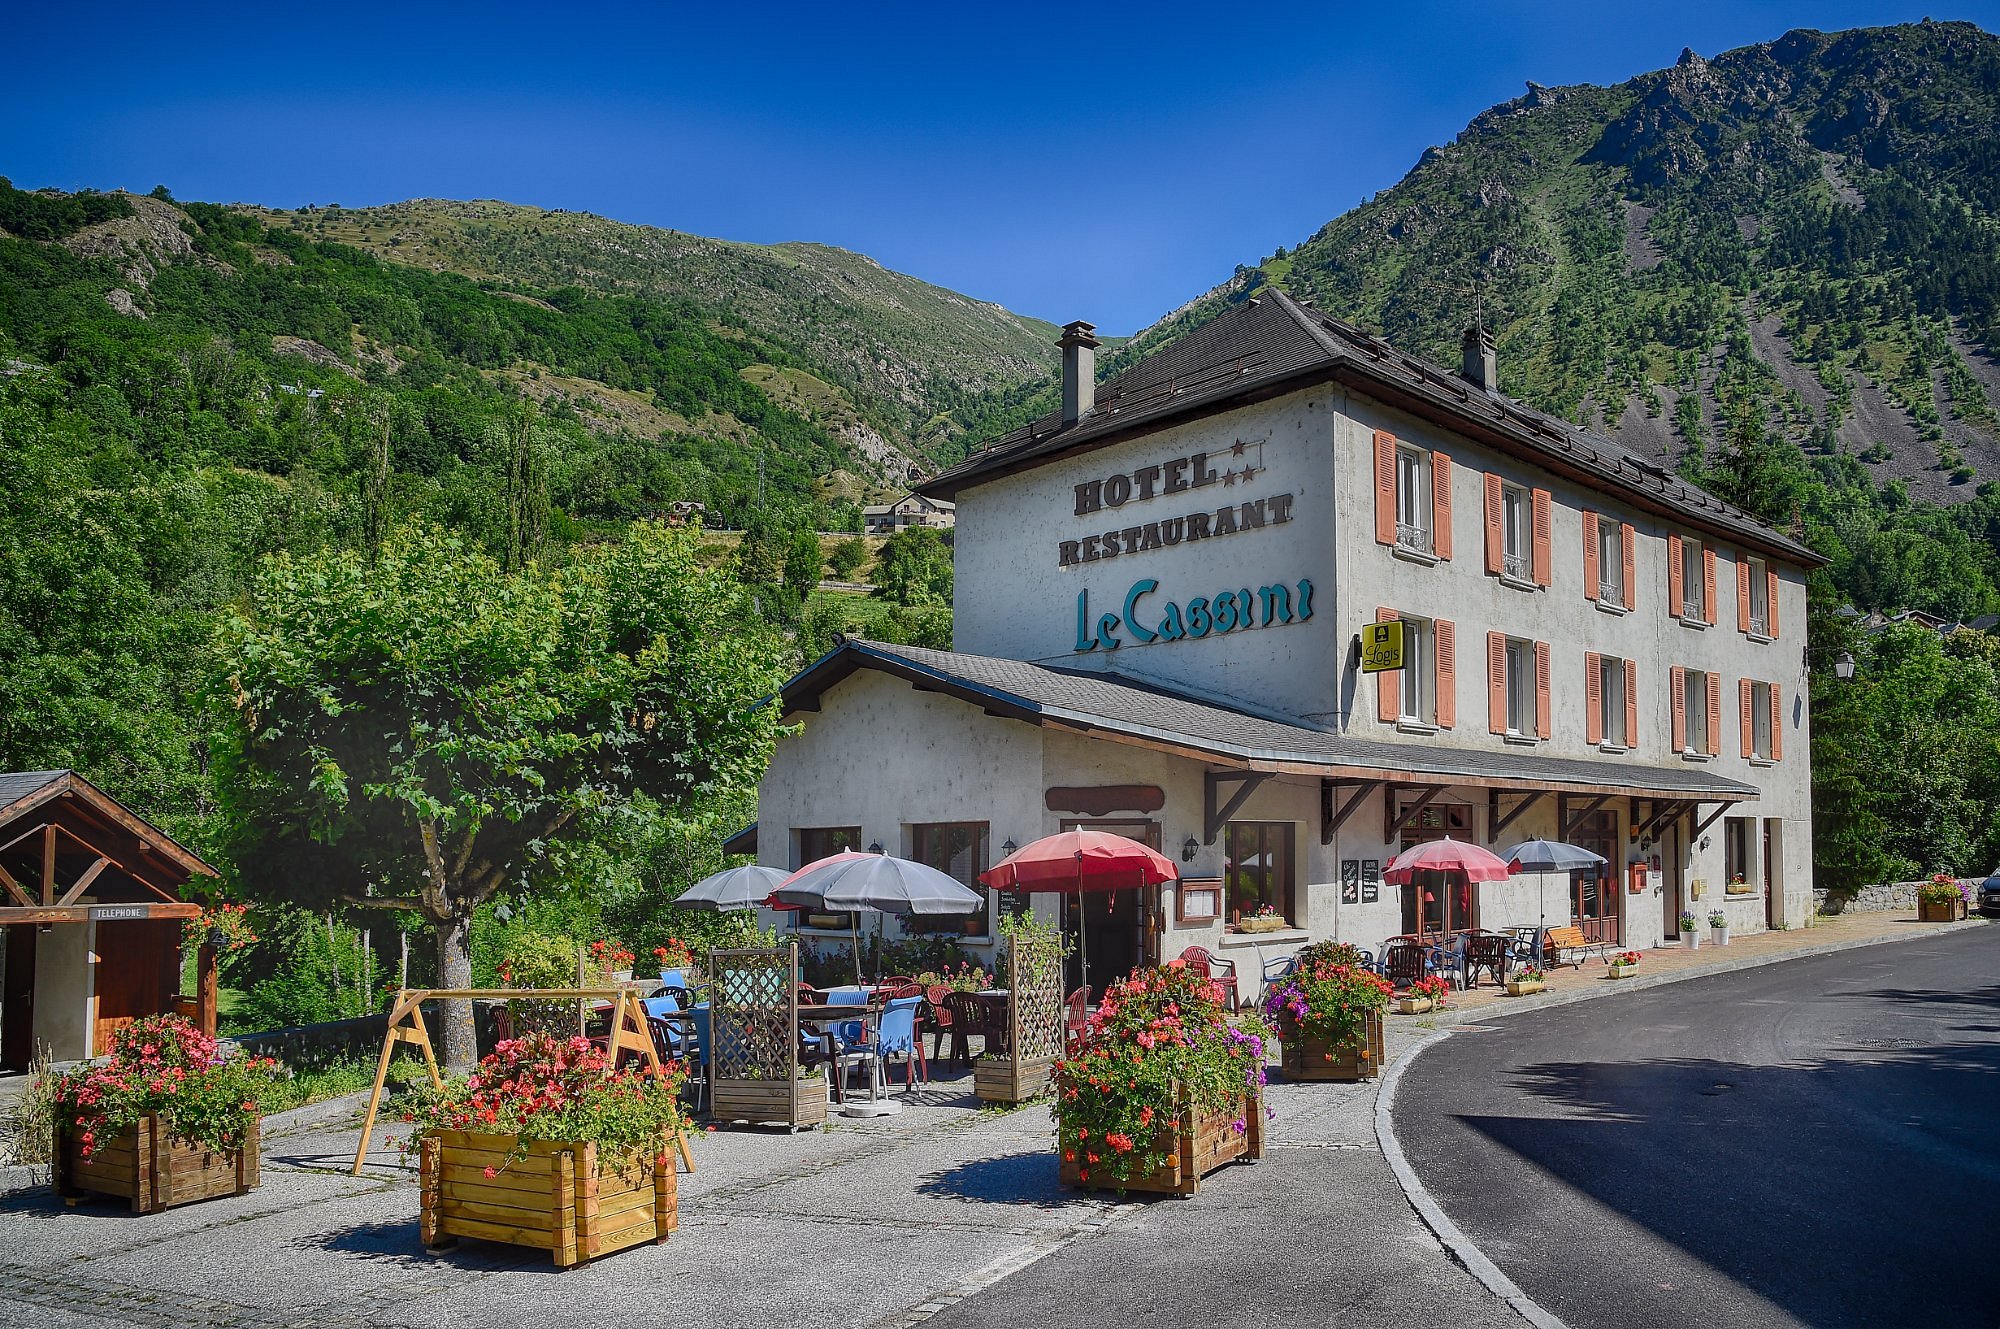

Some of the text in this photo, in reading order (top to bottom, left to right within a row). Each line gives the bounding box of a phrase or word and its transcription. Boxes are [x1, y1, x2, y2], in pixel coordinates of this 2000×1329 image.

[1074, 453, 1216, 516] HOTEL
[1059, 493, 1293, 567] RESTAURANT
[1073, 578, 1313, 651] Le Cassini
[1364, 643, 1399, 666] Logis
[97, 908, 141, 918] TELEPHONE
